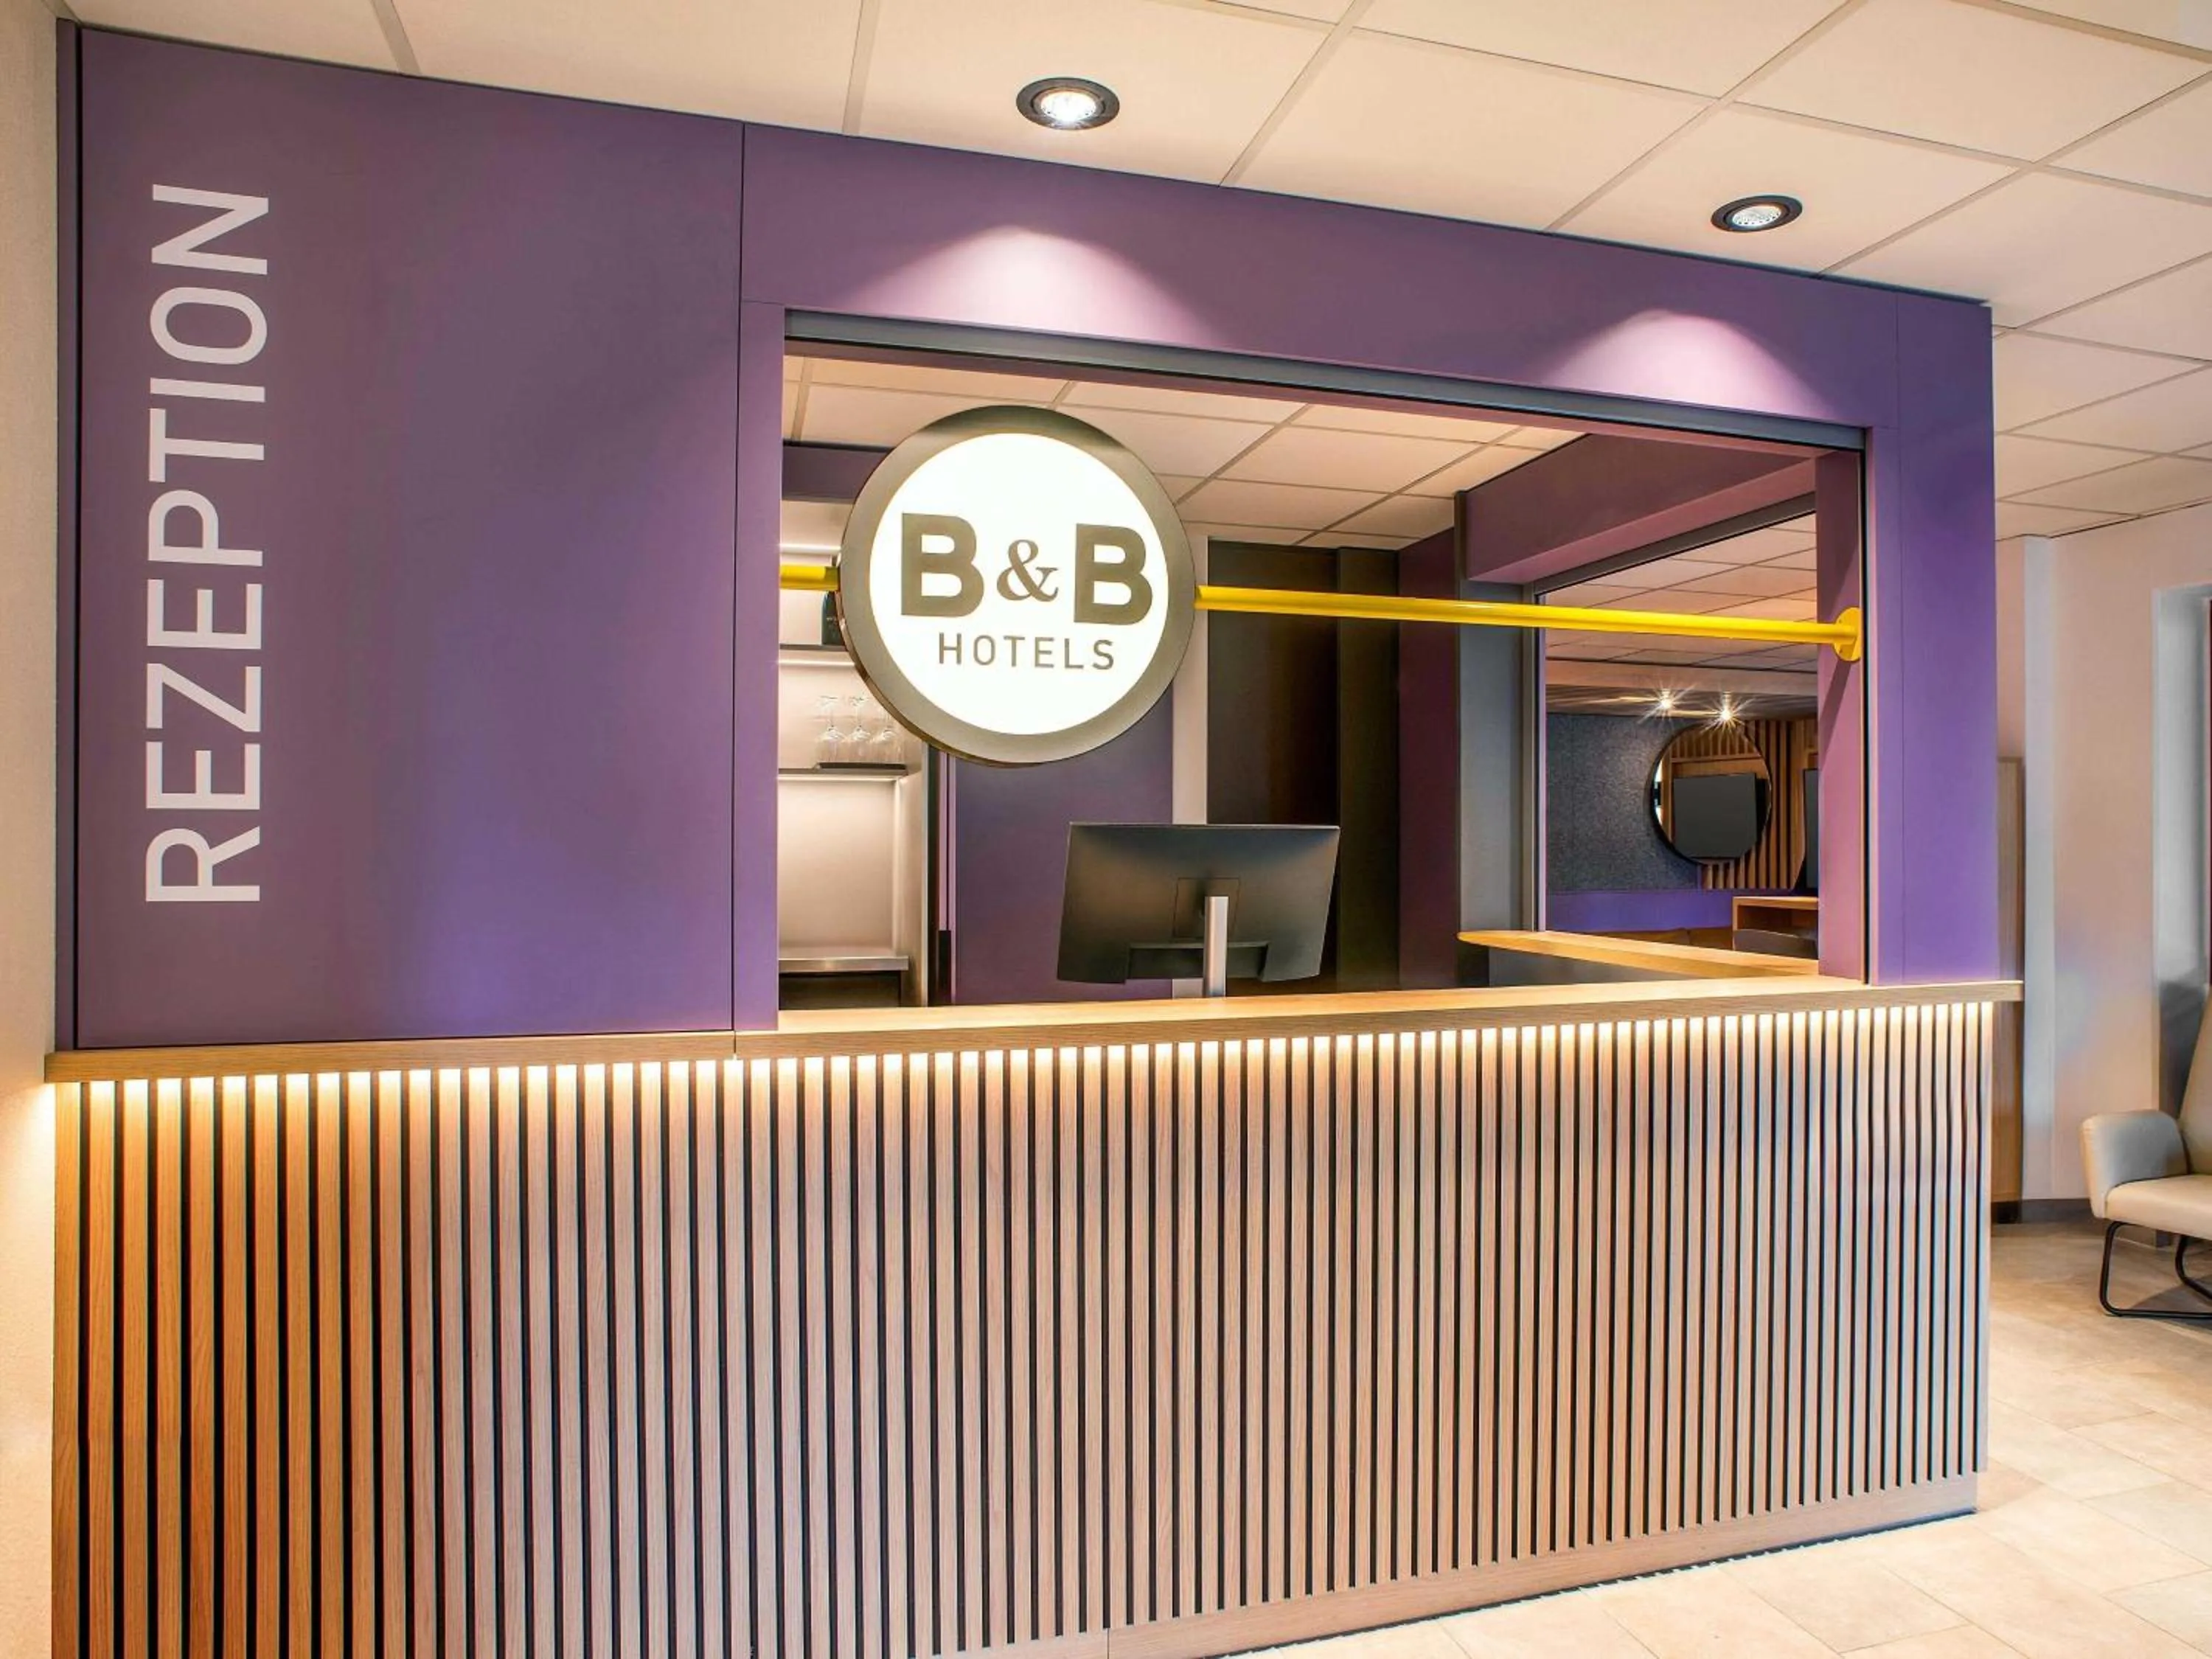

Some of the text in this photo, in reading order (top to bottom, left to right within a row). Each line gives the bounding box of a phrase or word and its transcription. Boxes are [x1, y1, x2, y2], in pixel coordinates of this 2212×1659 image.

[145, 184, 269, 902] REZEPTION
[900, 512, 1153, 626] B&B
[939, 633, 1114, 670] HOTELS
